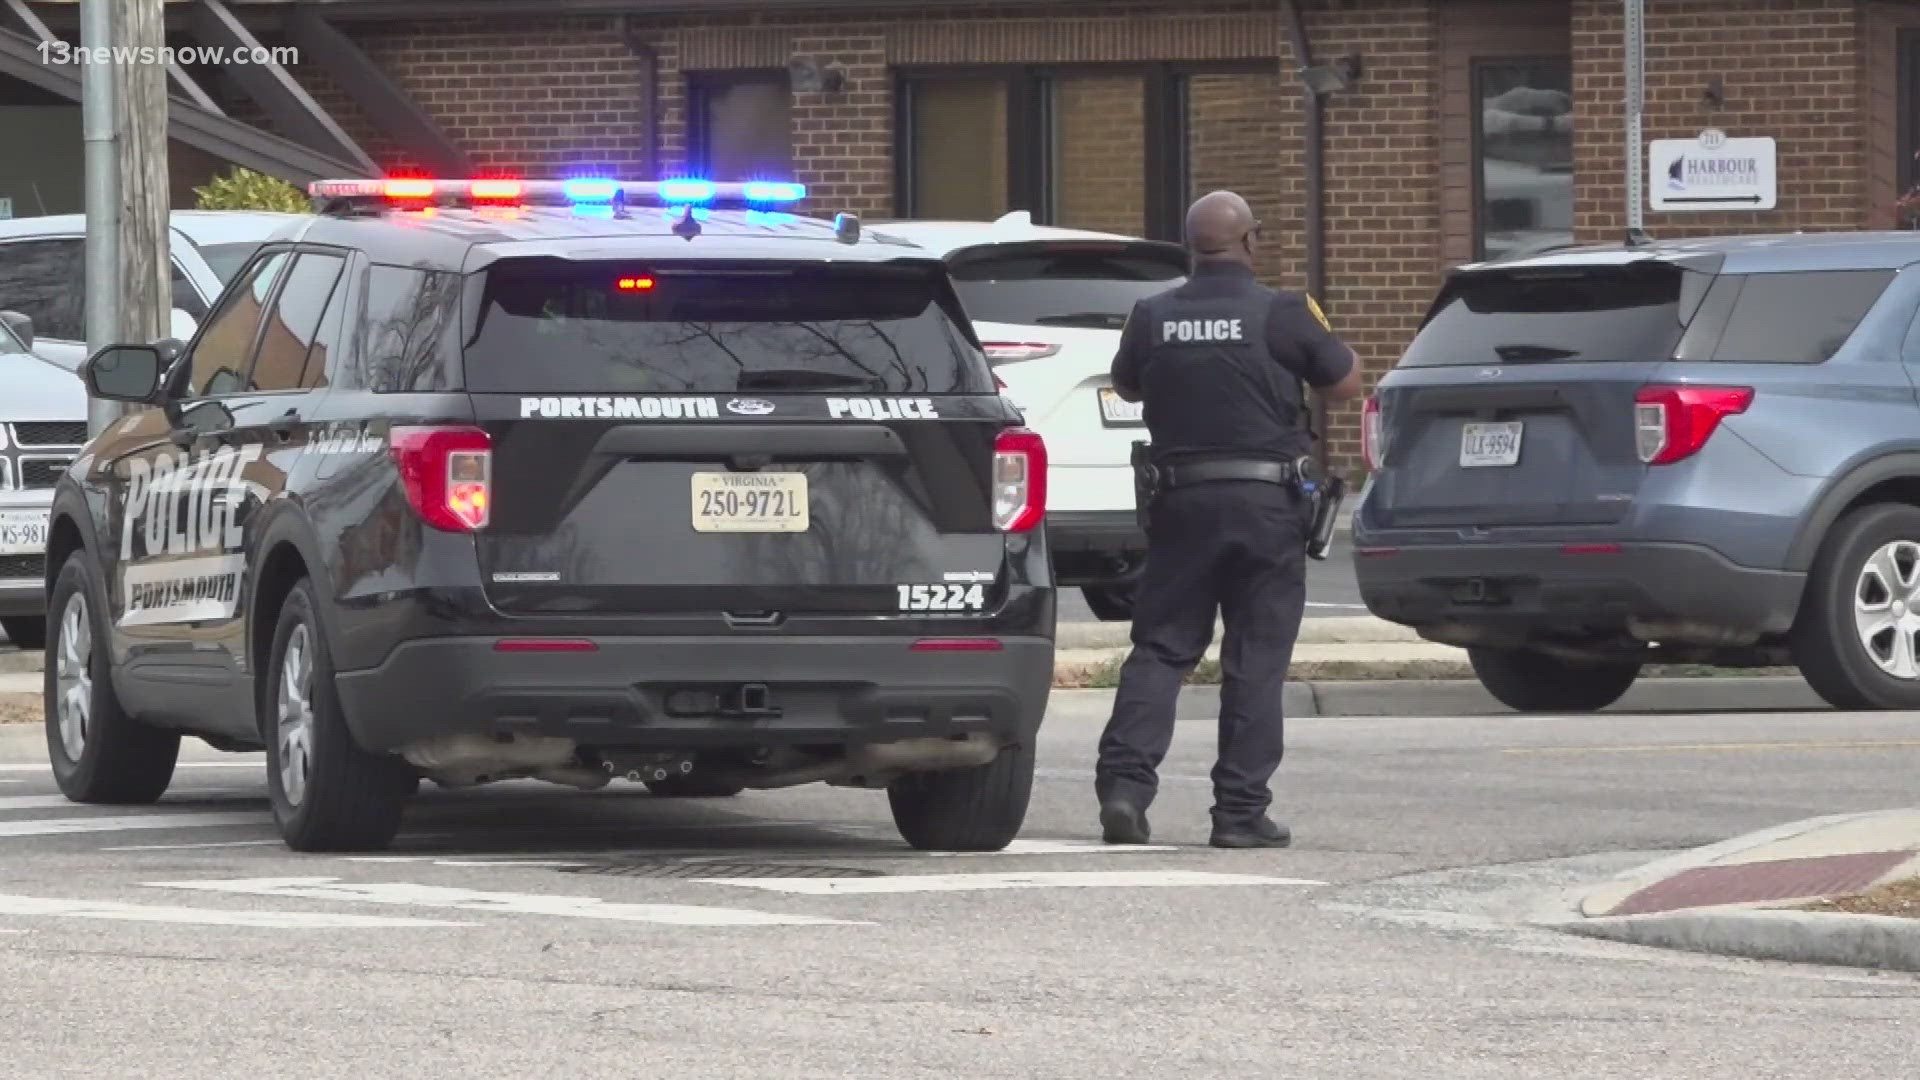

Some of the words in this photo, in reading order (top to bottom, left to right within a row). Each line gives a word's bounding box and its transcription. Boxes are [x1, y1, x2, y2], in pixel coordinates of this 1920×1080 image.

[1687, 157, 1757, 174] HARBOUR
[1163, 319, 1243, 342] POLICE
[520, 397, 719, 418] PORTSMOUTH
[826, 397, 938, 420] POLICE
[721, 477, 777, 487] VIRGINIA
[120, 443, 263, 560] POLICE
[700, 489, 801, 517] 250-972L
[129, 573, 236, 611] PORTSMOUTH
[897, 584, 984, 610] 15224
